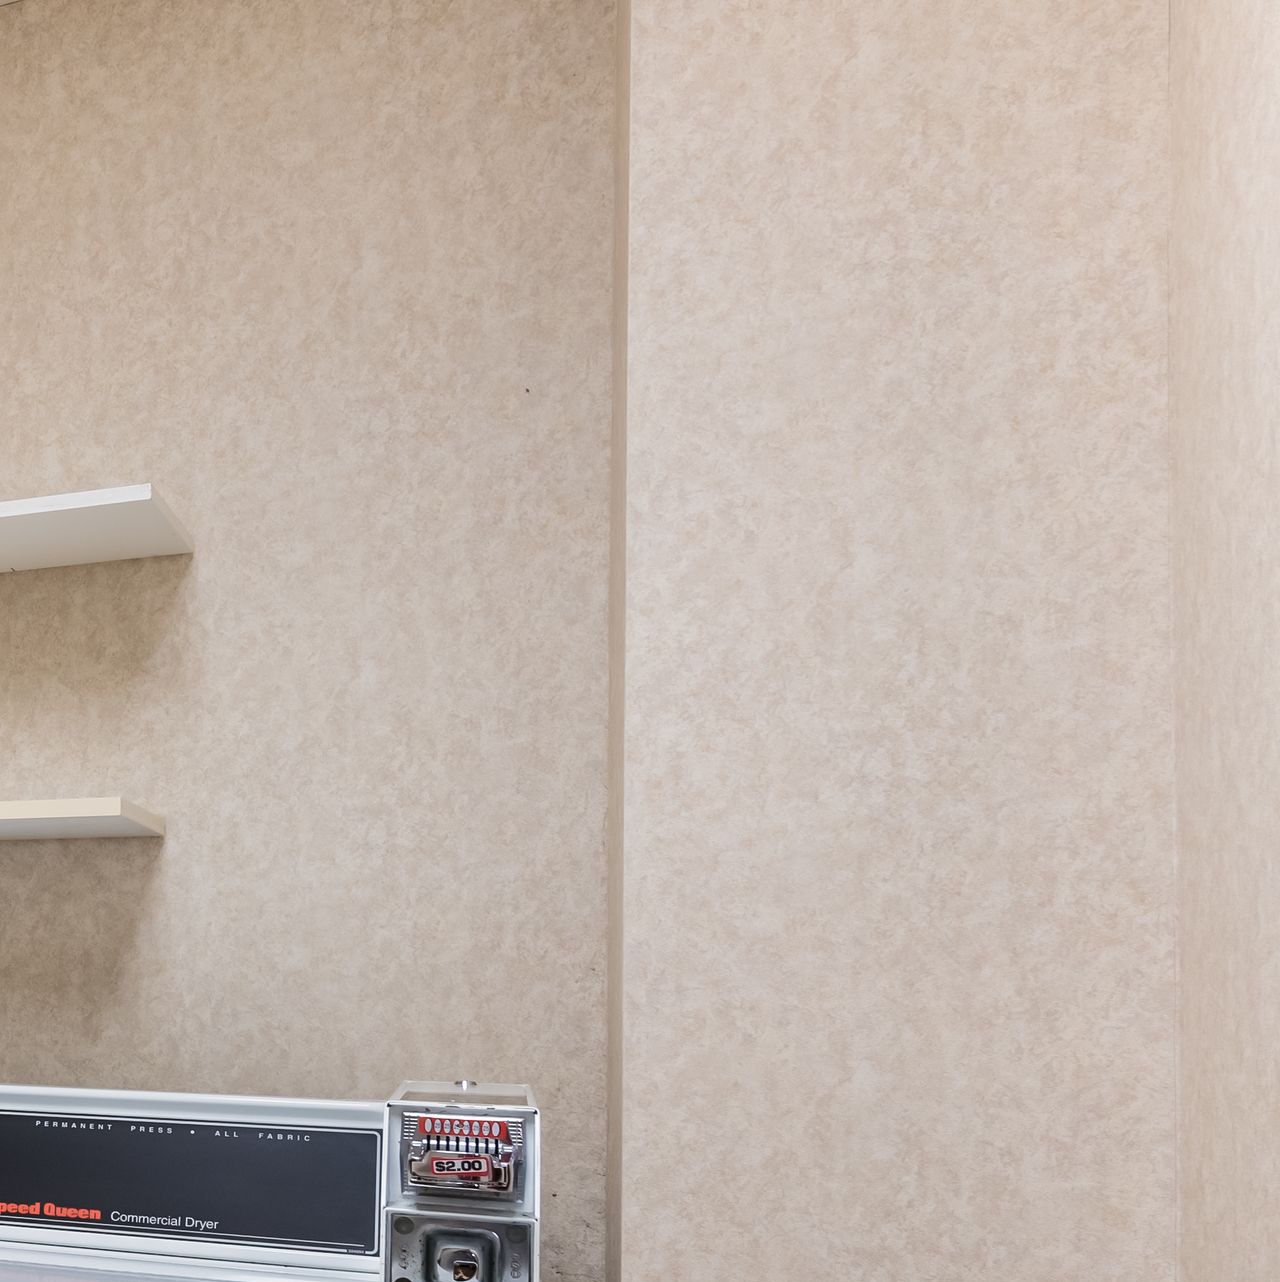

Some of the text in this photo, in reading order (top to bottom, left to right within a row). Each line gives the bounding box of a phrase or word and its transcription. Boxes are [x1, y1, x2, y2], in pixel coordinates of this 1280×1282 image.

[35, 1120, 172, 1133] PERMANENT PRESS
[258, 1132, 309, 1141] FABRIC
[435, 1160, 481, 1171] $2.00
[43, 1202, 101, 1219] Queen
[110, 1210, 181, 1226] Commercial
[185, 1216, 219, 1230] Dryer
